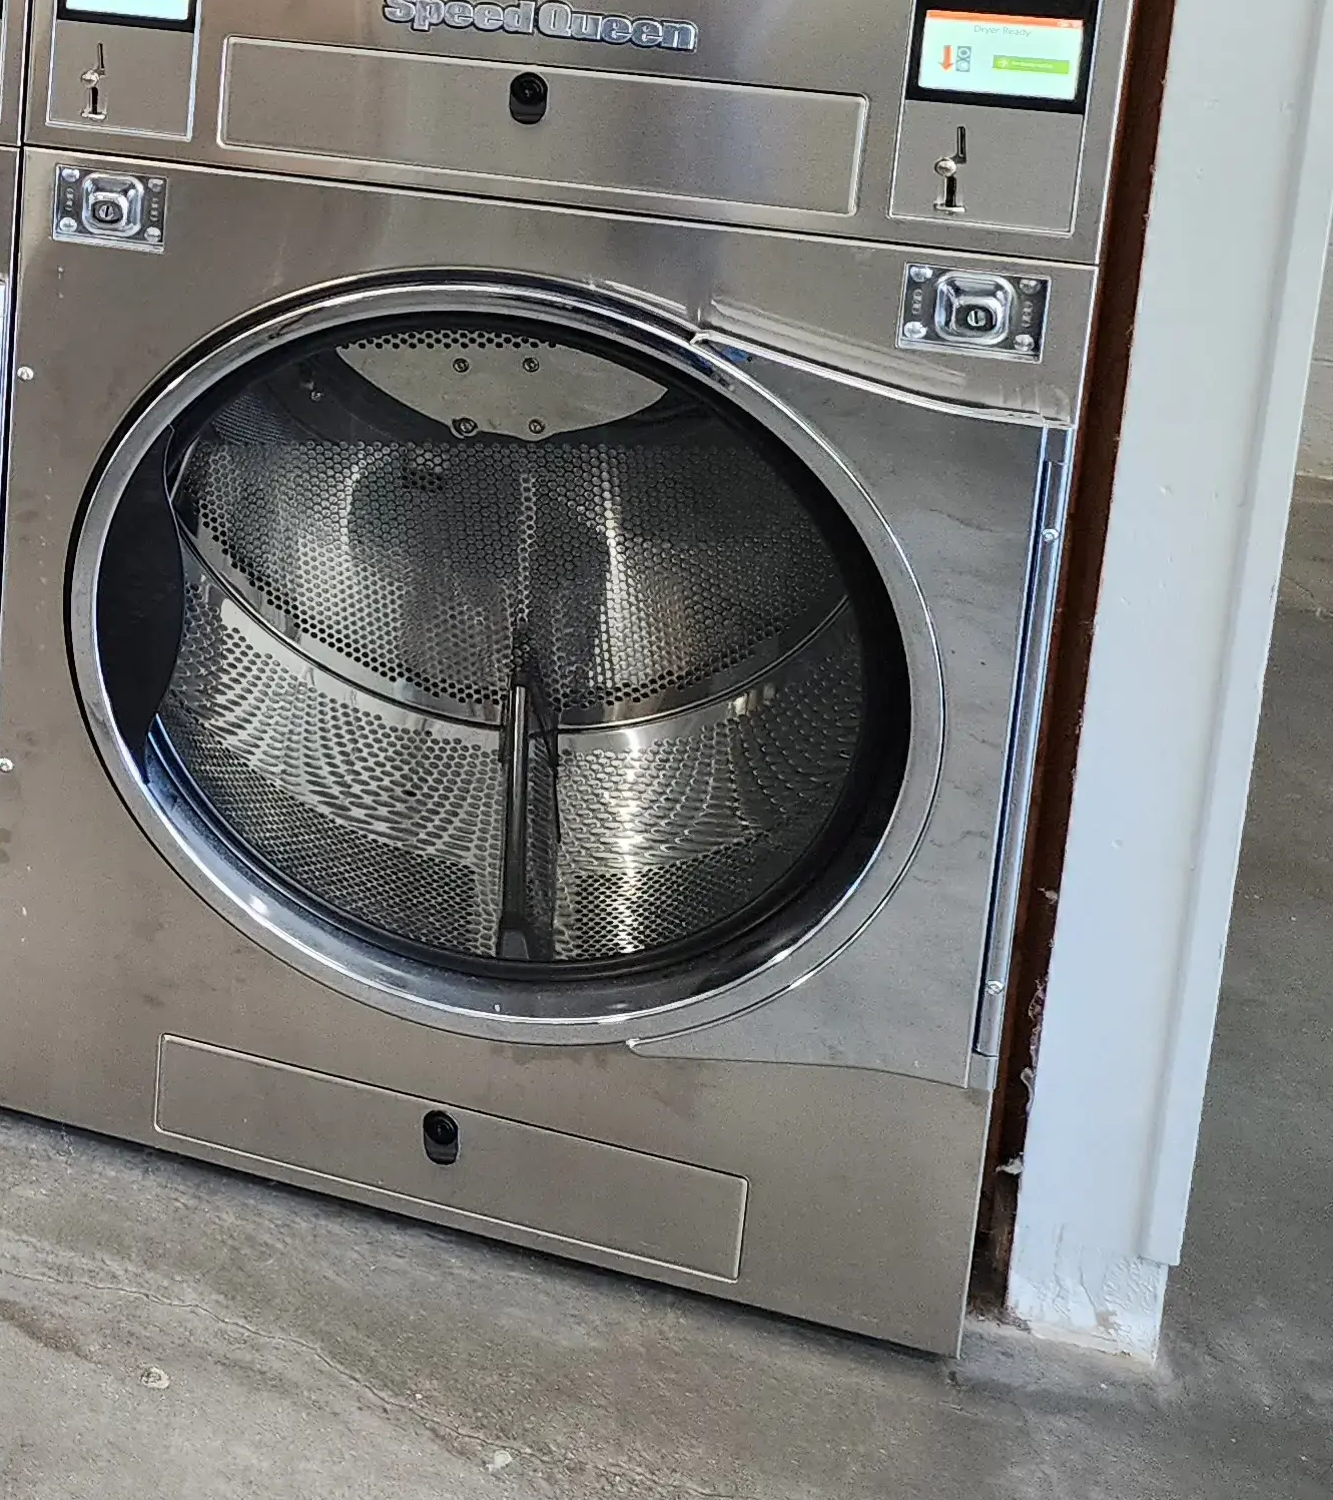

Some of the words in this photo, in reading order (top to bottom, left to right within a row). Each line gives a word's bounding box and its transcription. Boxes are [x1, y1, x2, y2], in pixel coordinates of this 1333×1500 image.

[537, 0, 698, 52] Queen
[973, 24, 1001, 35] Dryer
[1002, 26, 1032, 38] Ready
